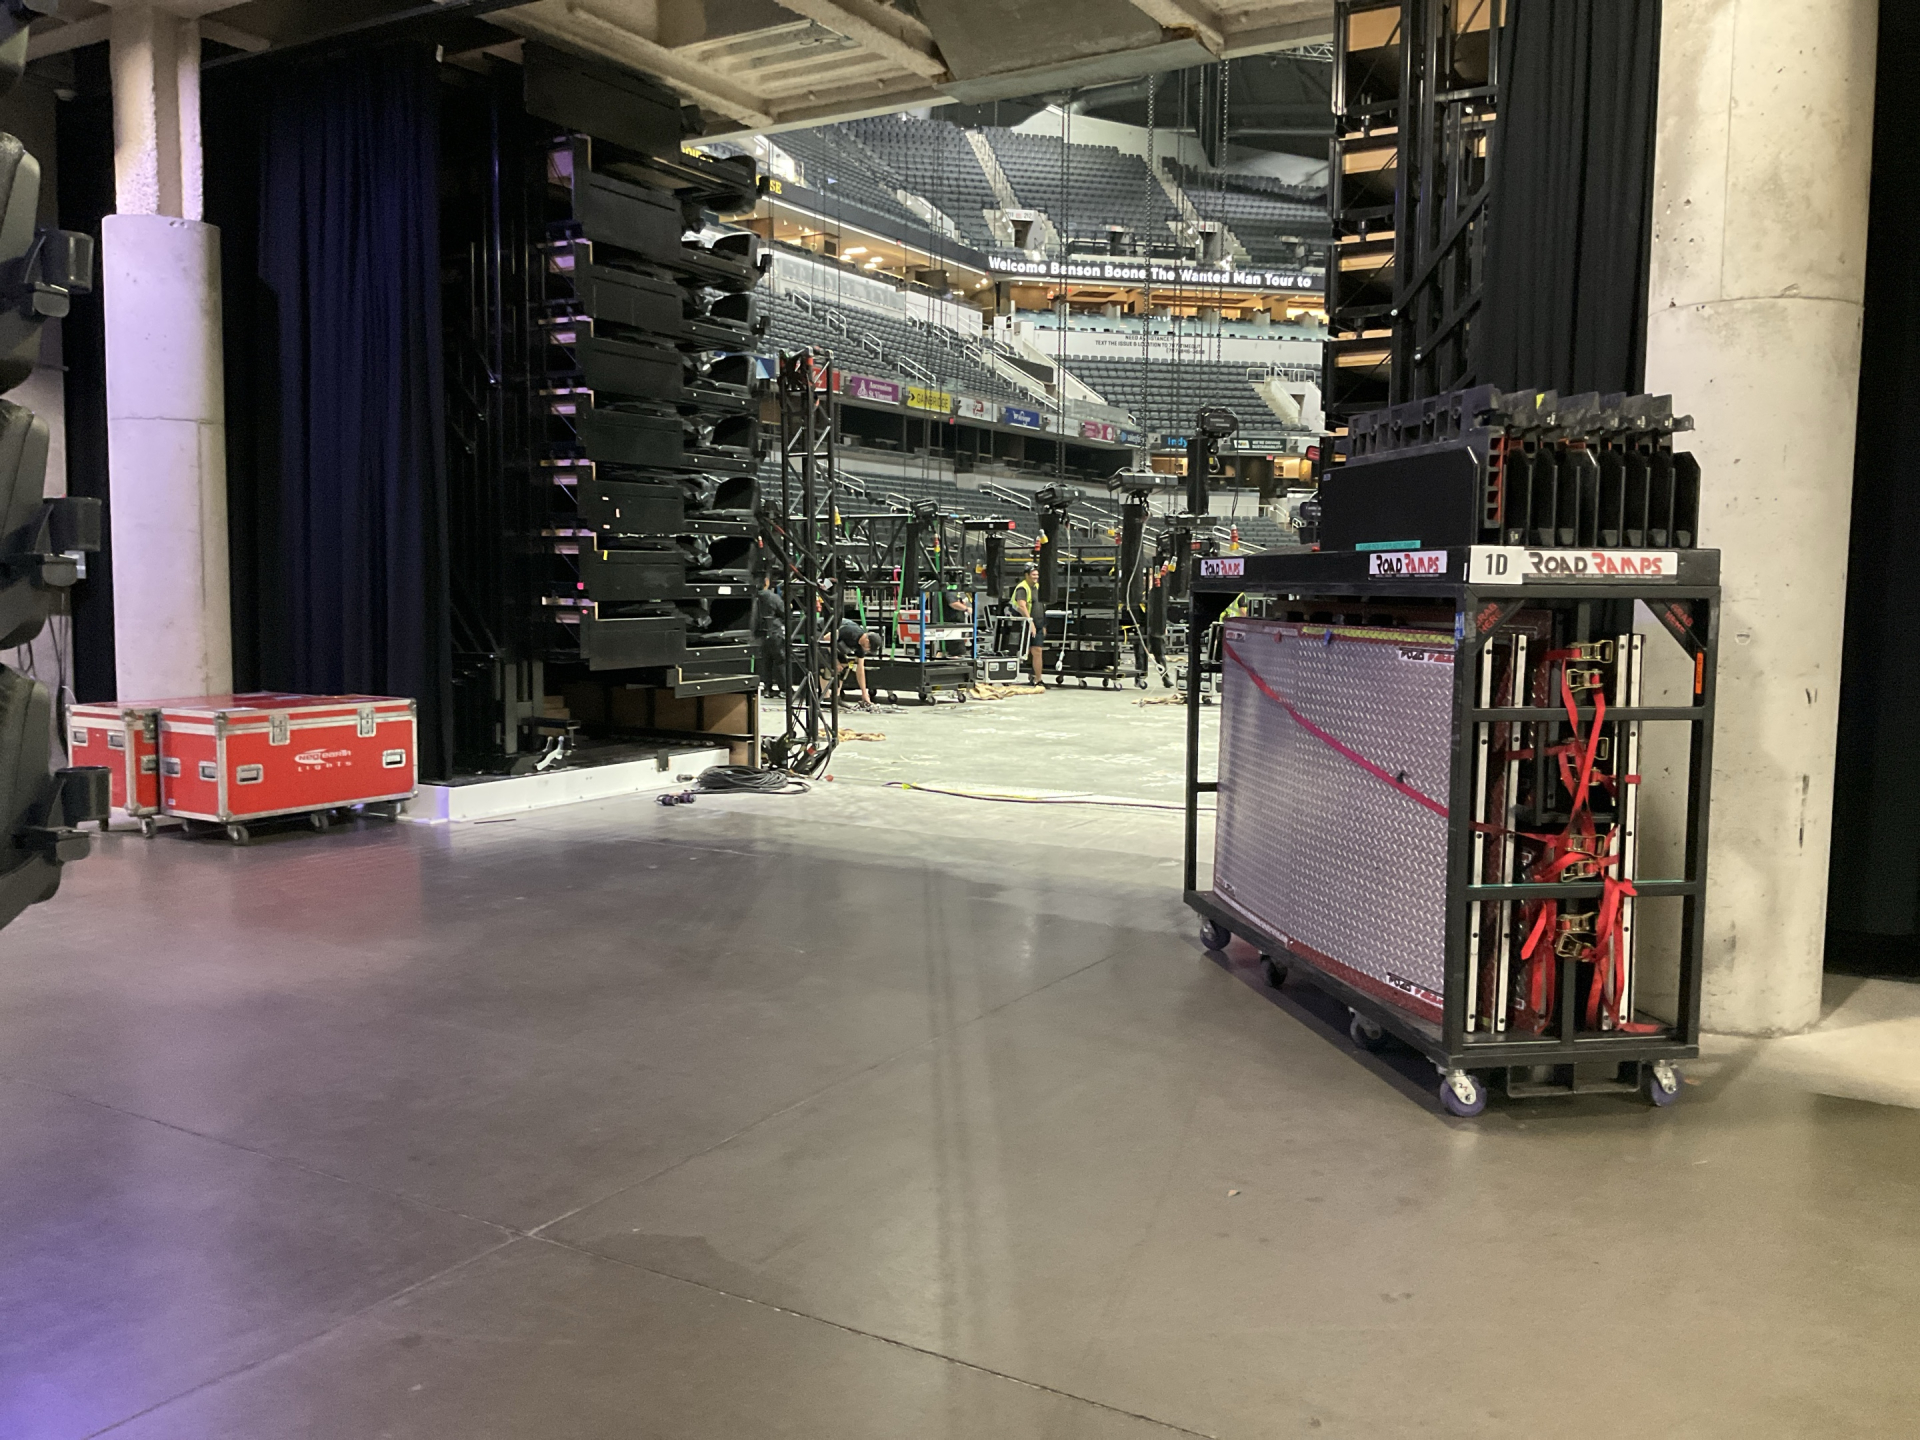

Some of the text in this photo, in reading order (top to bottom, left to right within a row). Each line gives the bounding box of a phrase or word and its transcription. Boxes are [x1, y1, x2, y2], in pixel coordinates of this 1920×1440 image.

[988, 256, 1312, 288] Welcome Benson Boone The Wanted Man Tour to
[1204, 559, 1240, 575] ROAD RAMPS
[1375, 552, 1439, 574] ROAD RAMPS
[1485, 553, 1508, 576] 1D
[1528, 551, 1663, 574] ROAD RAMPS
